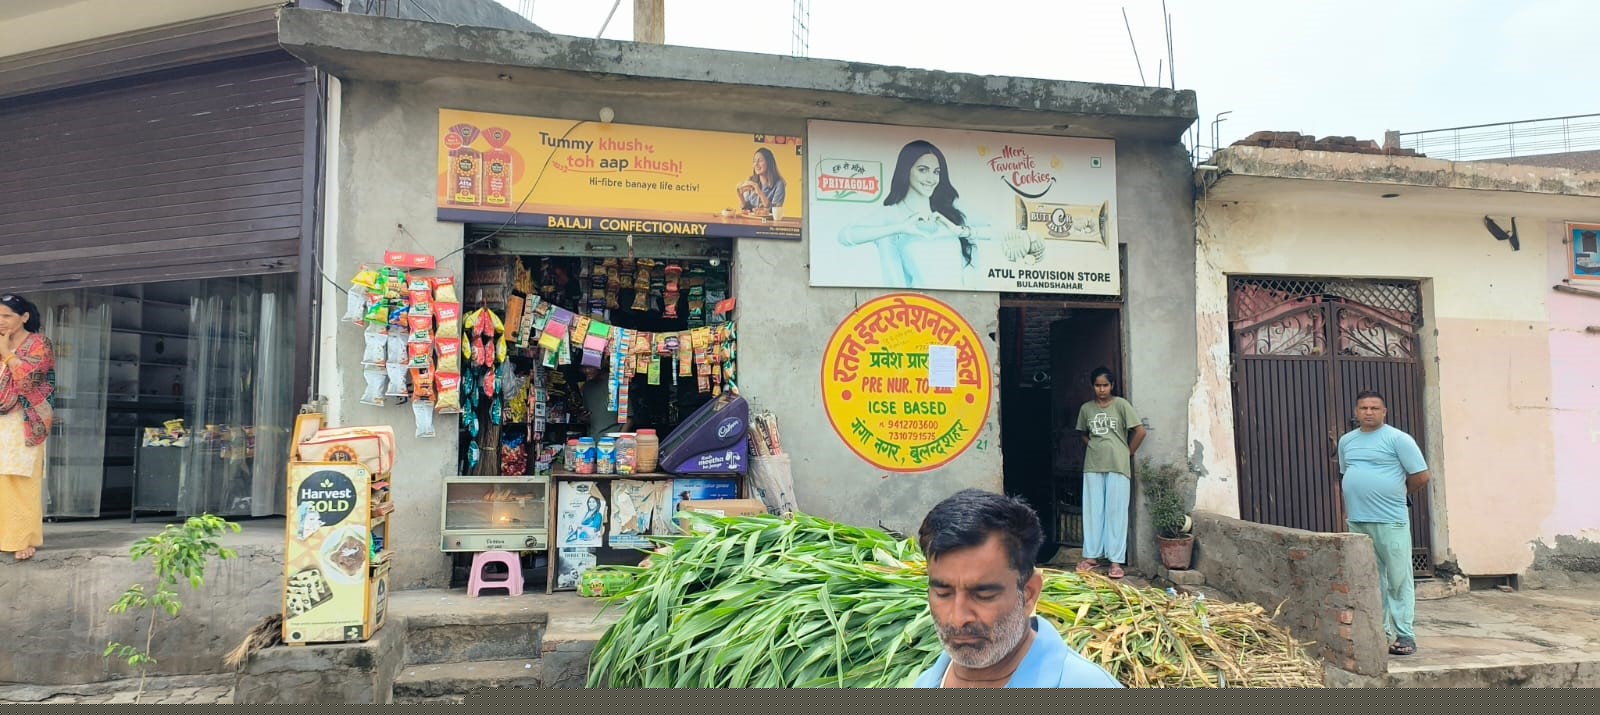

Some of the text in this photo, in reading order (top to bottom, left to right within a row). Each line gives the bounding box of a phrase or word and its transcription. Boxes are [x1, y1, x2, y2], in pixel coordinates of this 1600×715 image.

[538, 131, 643, 153] Tummy khush
[1002, 144, 1026, 159] Meri
[567, 154, 683, 174] toh aap khush!
[987, 155, 1036, 172] Favourite
[589, 177, 700, 193] Hi-fibre banaye life activ!
[822, 177, 875, 191] PRIYAGOLD
[1012, 170, 1051, 187] Cookies
[548, 215, 707, 236] BALAJI CONFECTIONARY
[988, 268, 1111, 282] ATUL PROVISION STORE
[1016, 281, 1083, 290] BULANDSHAHAR
[834, 334, 866, 382] रतन
[870, 347, 930, 369] प्रवेश प्रार
[862, 377, 882, 393] PRE
[887, 377, 913, 394] NUR.
[916, 378, 930, 394] TO
[868, 401, 947, 415] ICSE BASED
[850, 417, 873, 447] गंगा
[887, 419, 939, 429] 9412703600
[889, 432, 936, 441] 7310791575
[301, 488, 352, 499] Harvest
